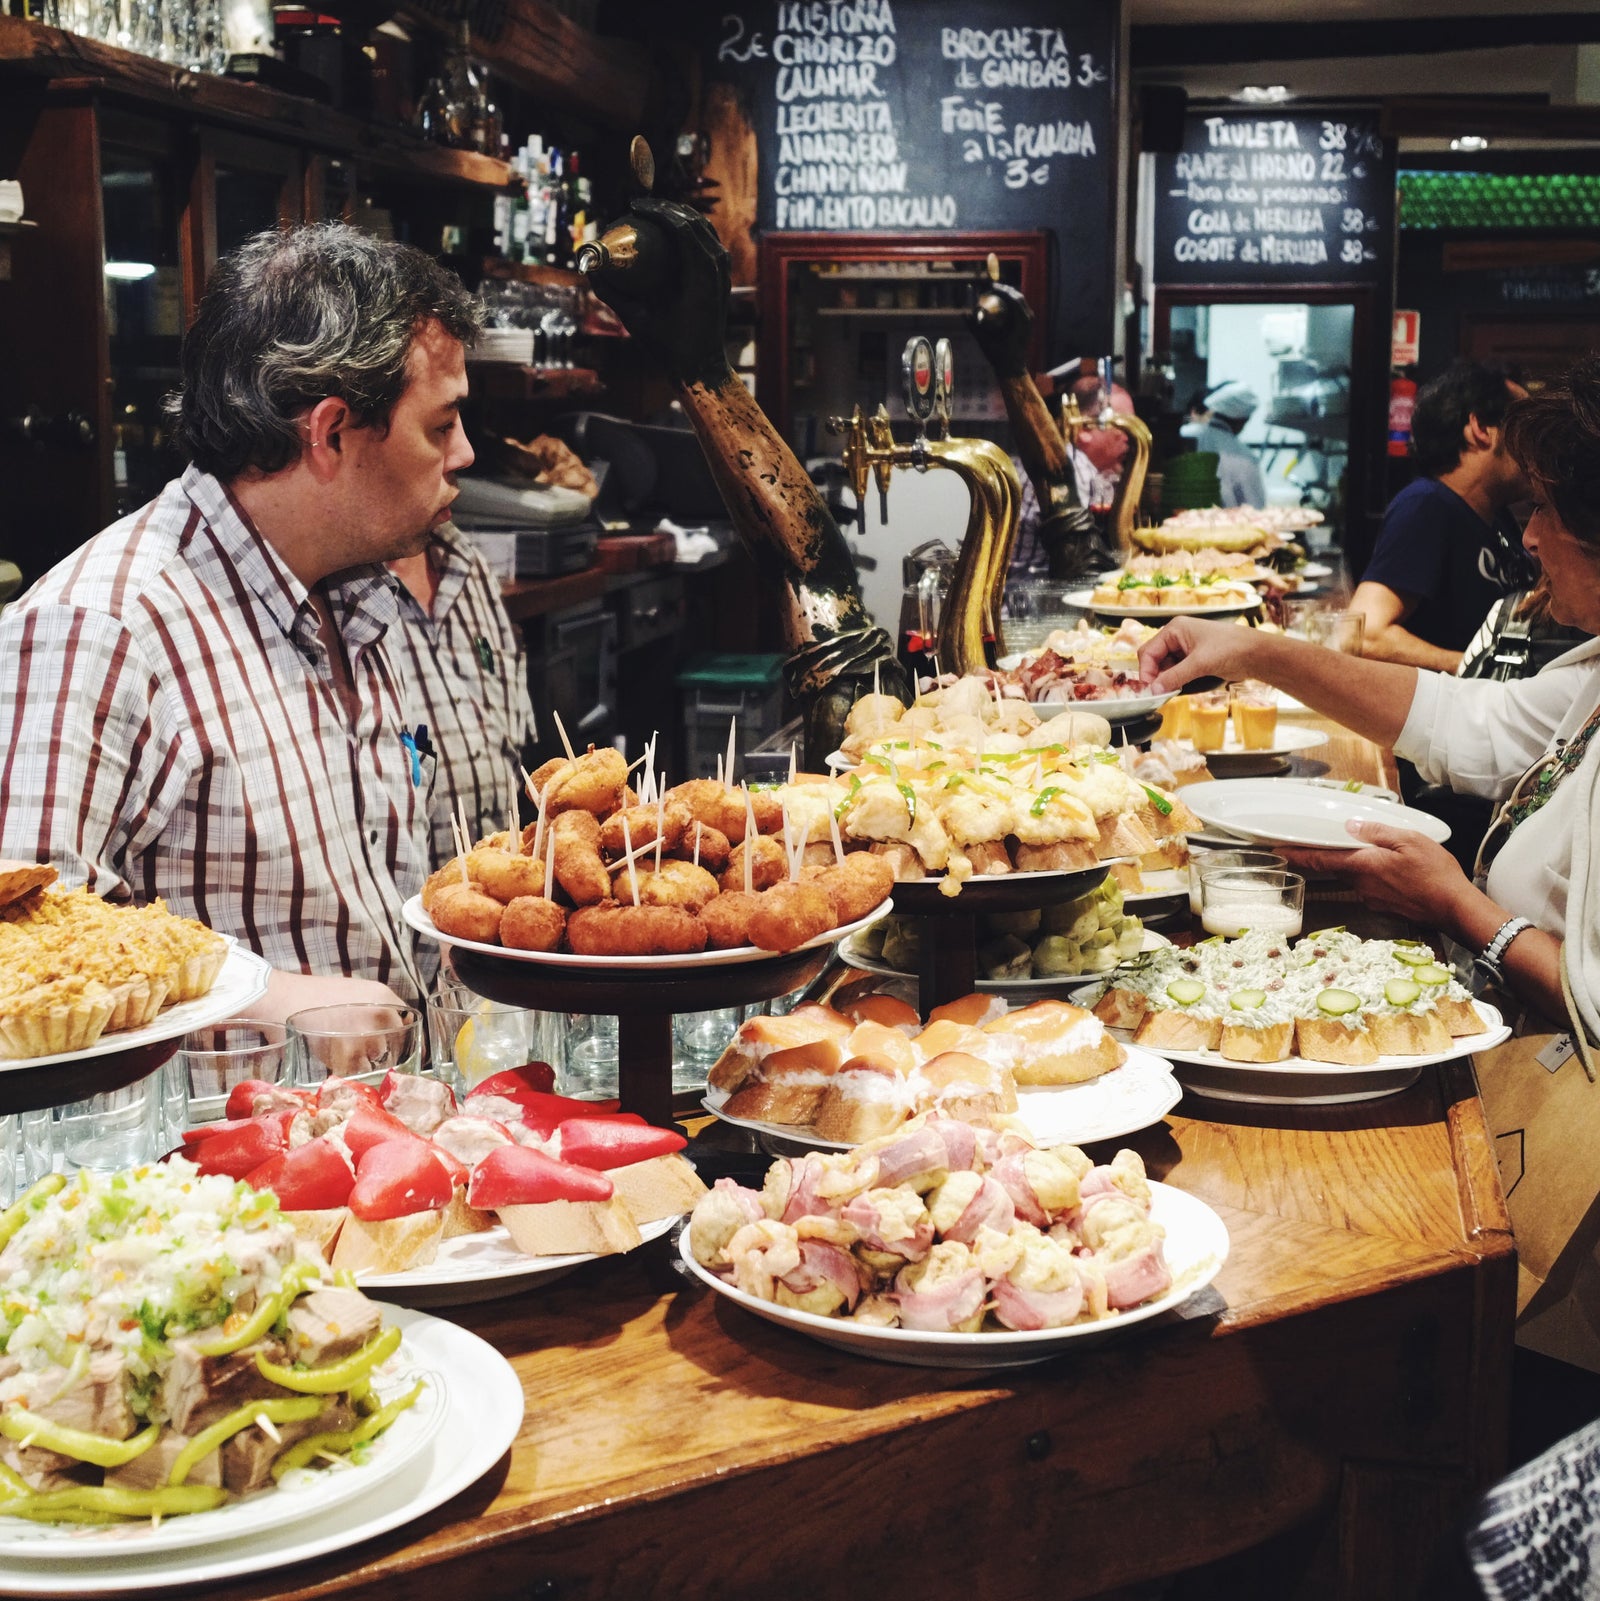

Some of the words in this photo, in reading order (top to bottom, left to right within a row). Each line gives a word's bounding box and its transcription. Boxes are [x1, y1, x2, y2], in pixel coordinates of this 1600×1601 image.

[941, 26, 1069, 60] BROCHETA
[980, 56, 1072, 88] GAMBAS
[962, 138, 984, 163] a
[1250, 151, 1317, 182] HORNO
[1240, 238, 1260, 264] de
